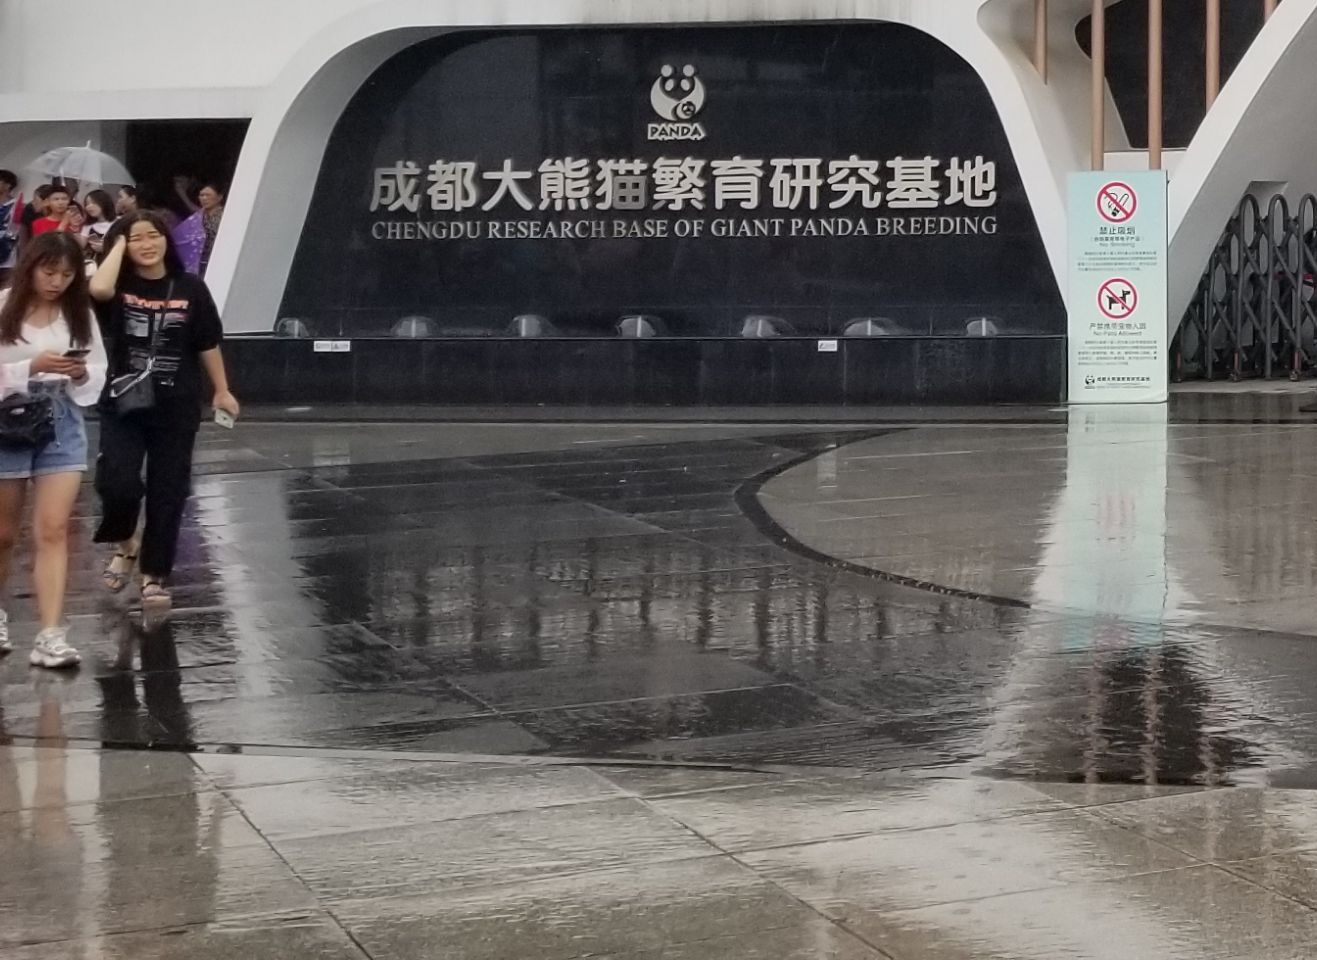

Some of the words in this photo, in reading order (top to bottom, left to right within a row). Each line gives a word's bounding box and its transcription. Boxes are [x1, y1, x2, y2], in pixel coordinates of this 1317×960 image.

[648, 123, 706, 140] PANDA
[369, 155, 998, 213] 成都大熊猫繁育研究基地
[371, 221, 481, 240] CHENGDU
[487, 220, 606, 239] RESEARCH
[612, 219, 668, 238] BASE
[674, 219, 704, 238] OF
[710, 218, 784, 238] GIANT
[791, 217, 869, 236] PANDA
[875, 215, 998, 235] BREEDING
